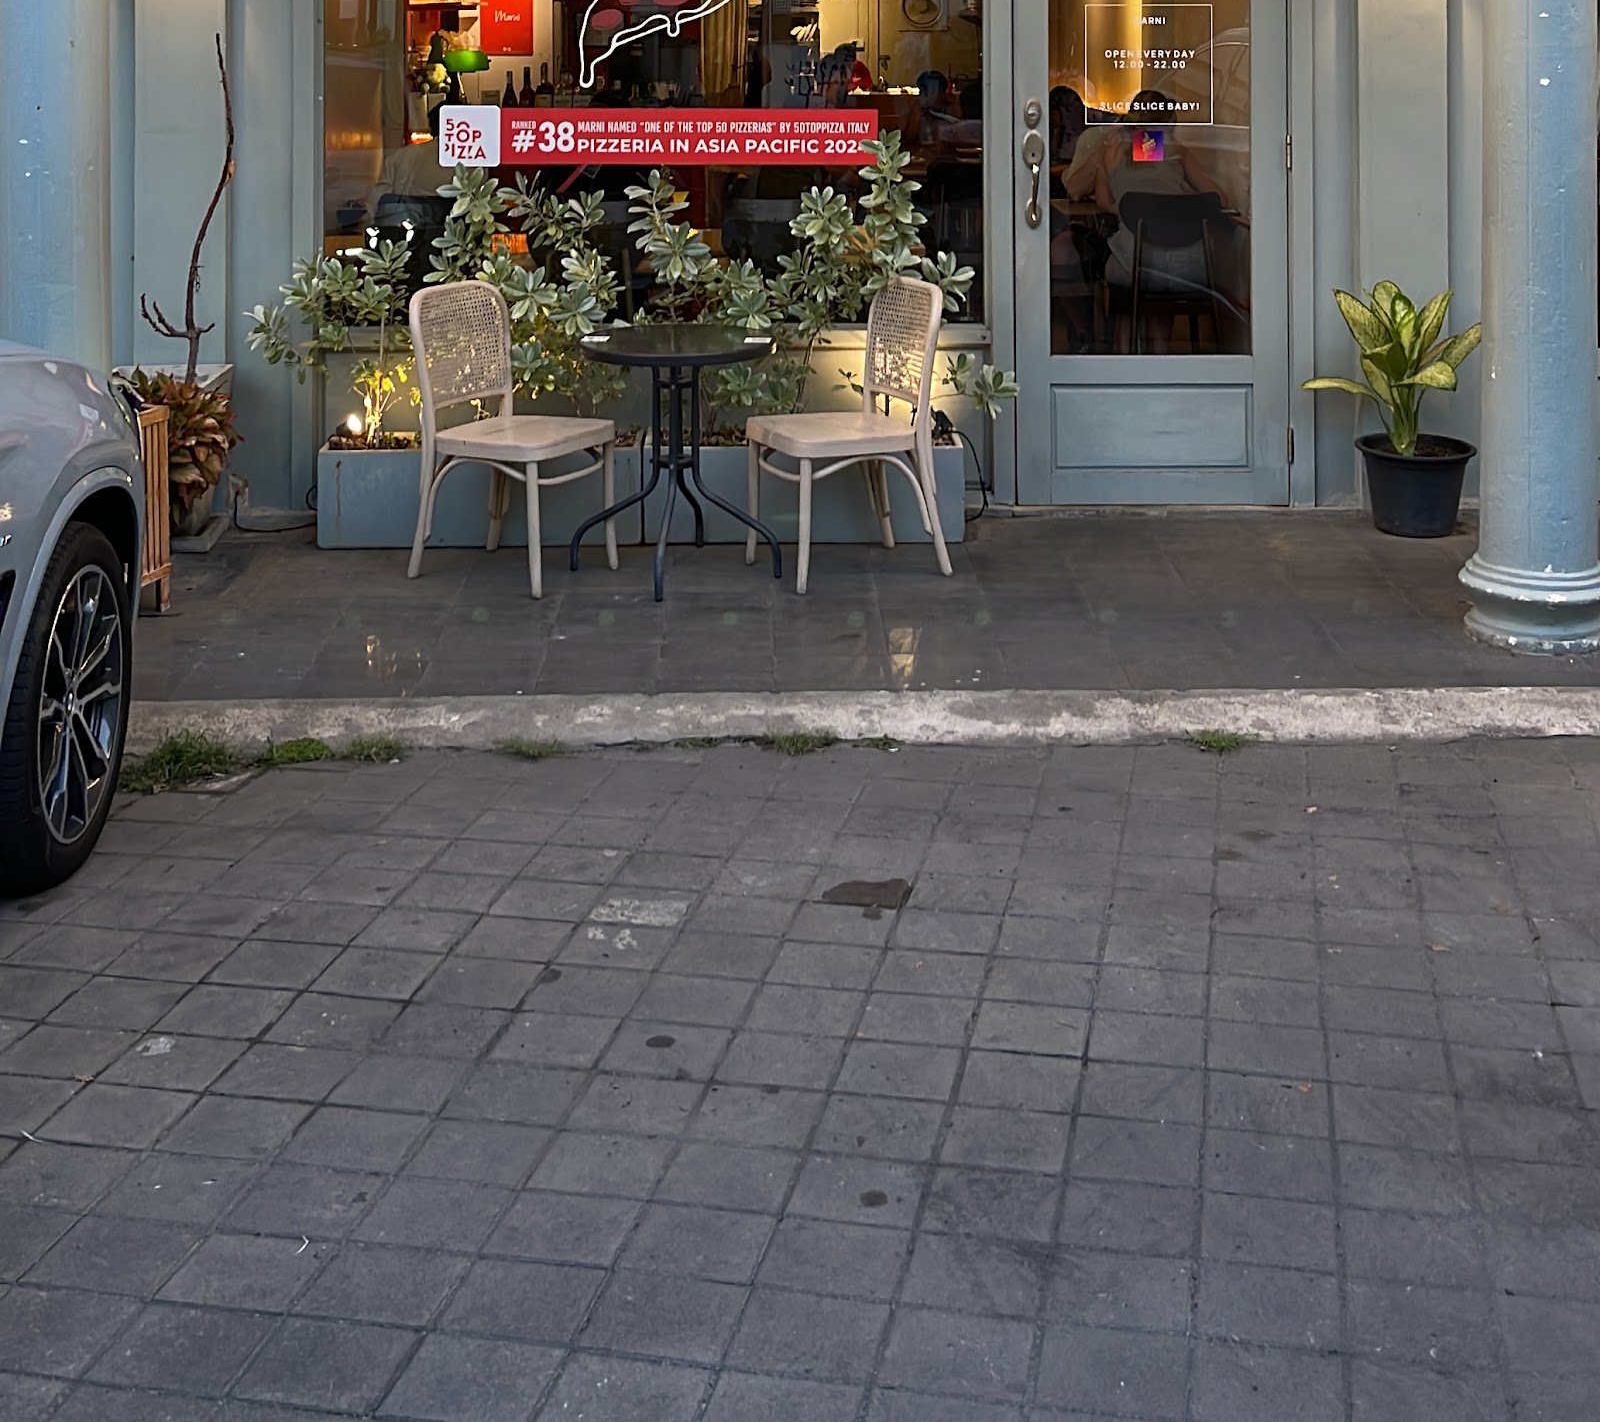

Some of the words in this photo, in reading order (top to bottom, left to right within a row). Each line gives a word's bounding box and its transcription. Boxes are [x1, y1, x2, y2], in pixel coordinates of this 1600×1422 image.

[1134, 17, 1166, 25] ARNI
[1104, 50, 1134, 58] OPEN
[1137, 50, 1171, 58] EVERY
[1173, 50, 1195, 58] DAY
[1113, 61, 1144, 69] 12.00
[1153, 61, 1186, 69] 22.00
[1100, 102, 1130, 110] SLICE
[1133, 102, 1165, 110] SLICE
[1167, 102, 1200, 110] BABY!
[511, 121, 537, 129] RANKED
[577, 121, 605, 133] MARNI
[608, 121, 637, 133] NAMED
[664, 121, 675, 133] OF
[677, 121, 693, 133] THE
[696, 121, 713, 133] TOP
[716, 121, 727, 133] 50
[779, 121, 791, 133] BY
[794, 121, 845, 133] 50TOPPIZZA
[847, 121, 870, 133] ITALY
[445, 130, 482, 143] TOP
[511, 121, 575, 153] #38
[577, 139, 664, 153] PIZZERIA
[670, 139, 689, 153] IN
[694, 139, 740, 153] ASIA
[745, 139, 819, 153] PACIFIC
[825, 139, 864, 154] 202
